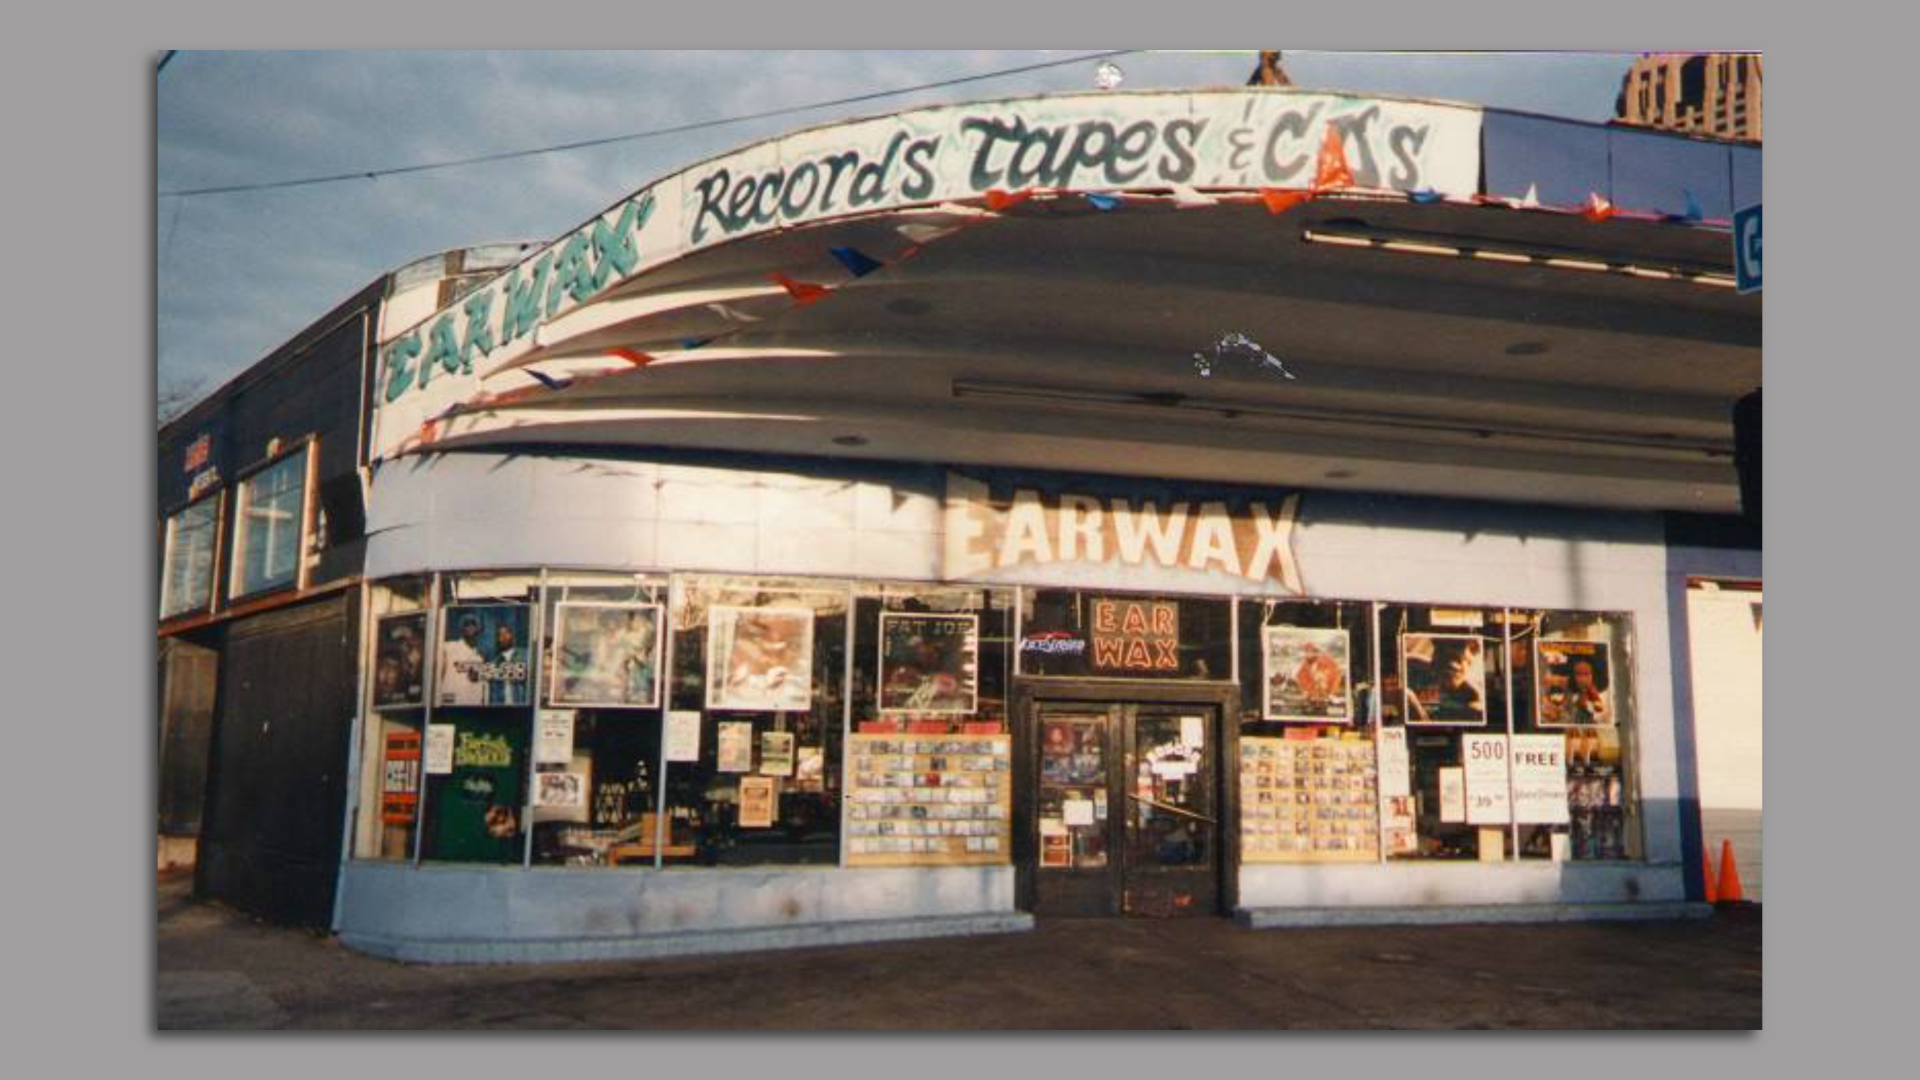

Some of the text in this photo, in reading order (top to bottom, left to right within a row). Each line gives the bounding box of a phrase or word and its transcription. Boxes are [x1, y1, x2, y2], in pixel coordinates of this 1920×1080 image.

[691, 129, 942, 244] Records
[945, 471, 1306, 596] EARWAX
[1095, 600, 1175, 635] EAR
[1094, 637, 1178, 668] WAX
[1471, 740, 1504, 760] 500
[1514, 752, 1559, 766] FREE
